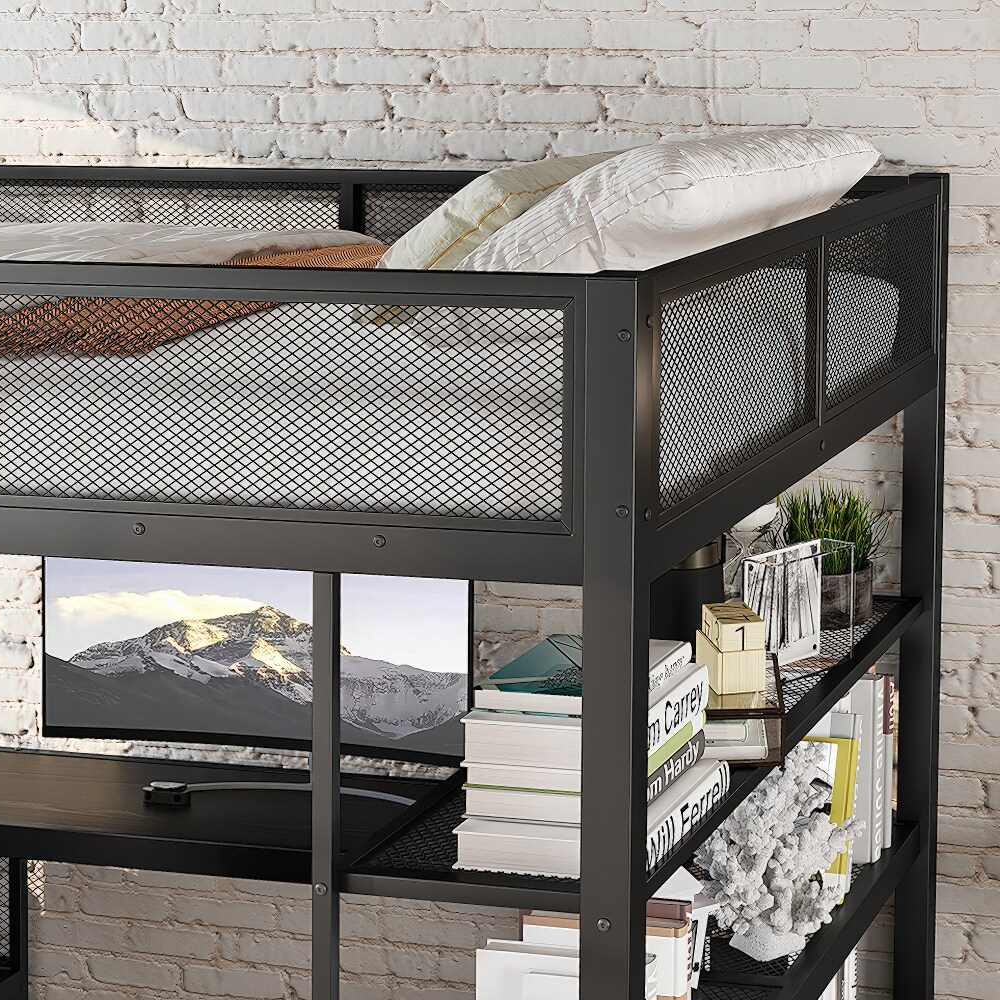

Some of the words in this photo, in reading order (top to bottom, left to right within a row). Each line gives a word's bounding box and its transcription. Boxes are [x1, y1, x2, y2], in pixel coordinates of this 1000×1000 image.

[735, 626, 745, 651] 1
[664, 681, 704, 735] Carrey
[664, 740, 700, 786] Hardy
[680, 760, 730, 843] Ferrell
